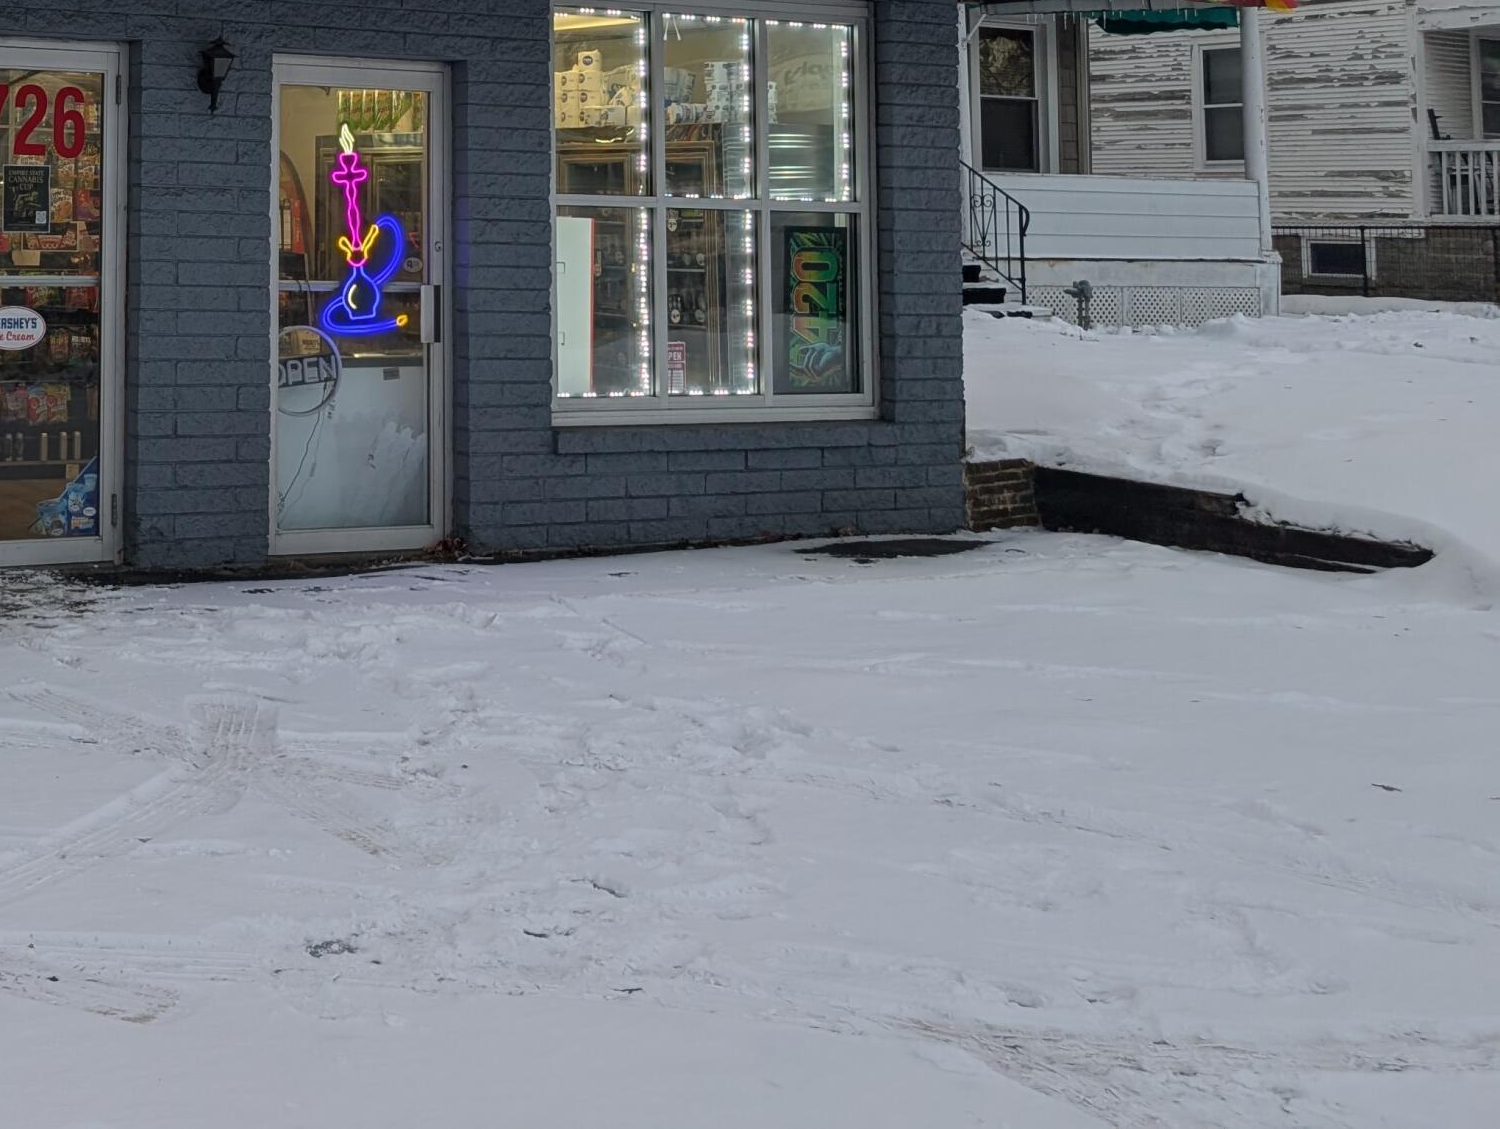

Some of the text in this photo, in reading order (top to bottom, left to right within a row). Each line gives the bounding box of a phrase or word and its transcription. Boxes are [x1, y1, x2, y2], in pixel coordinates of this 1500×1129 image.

[8, 175, 44, 183] CANNABIS
[791, 246, 838, 346] 420
[6, 332, 35, 341] Cream
[278, 356, 337, 386] OPEN
